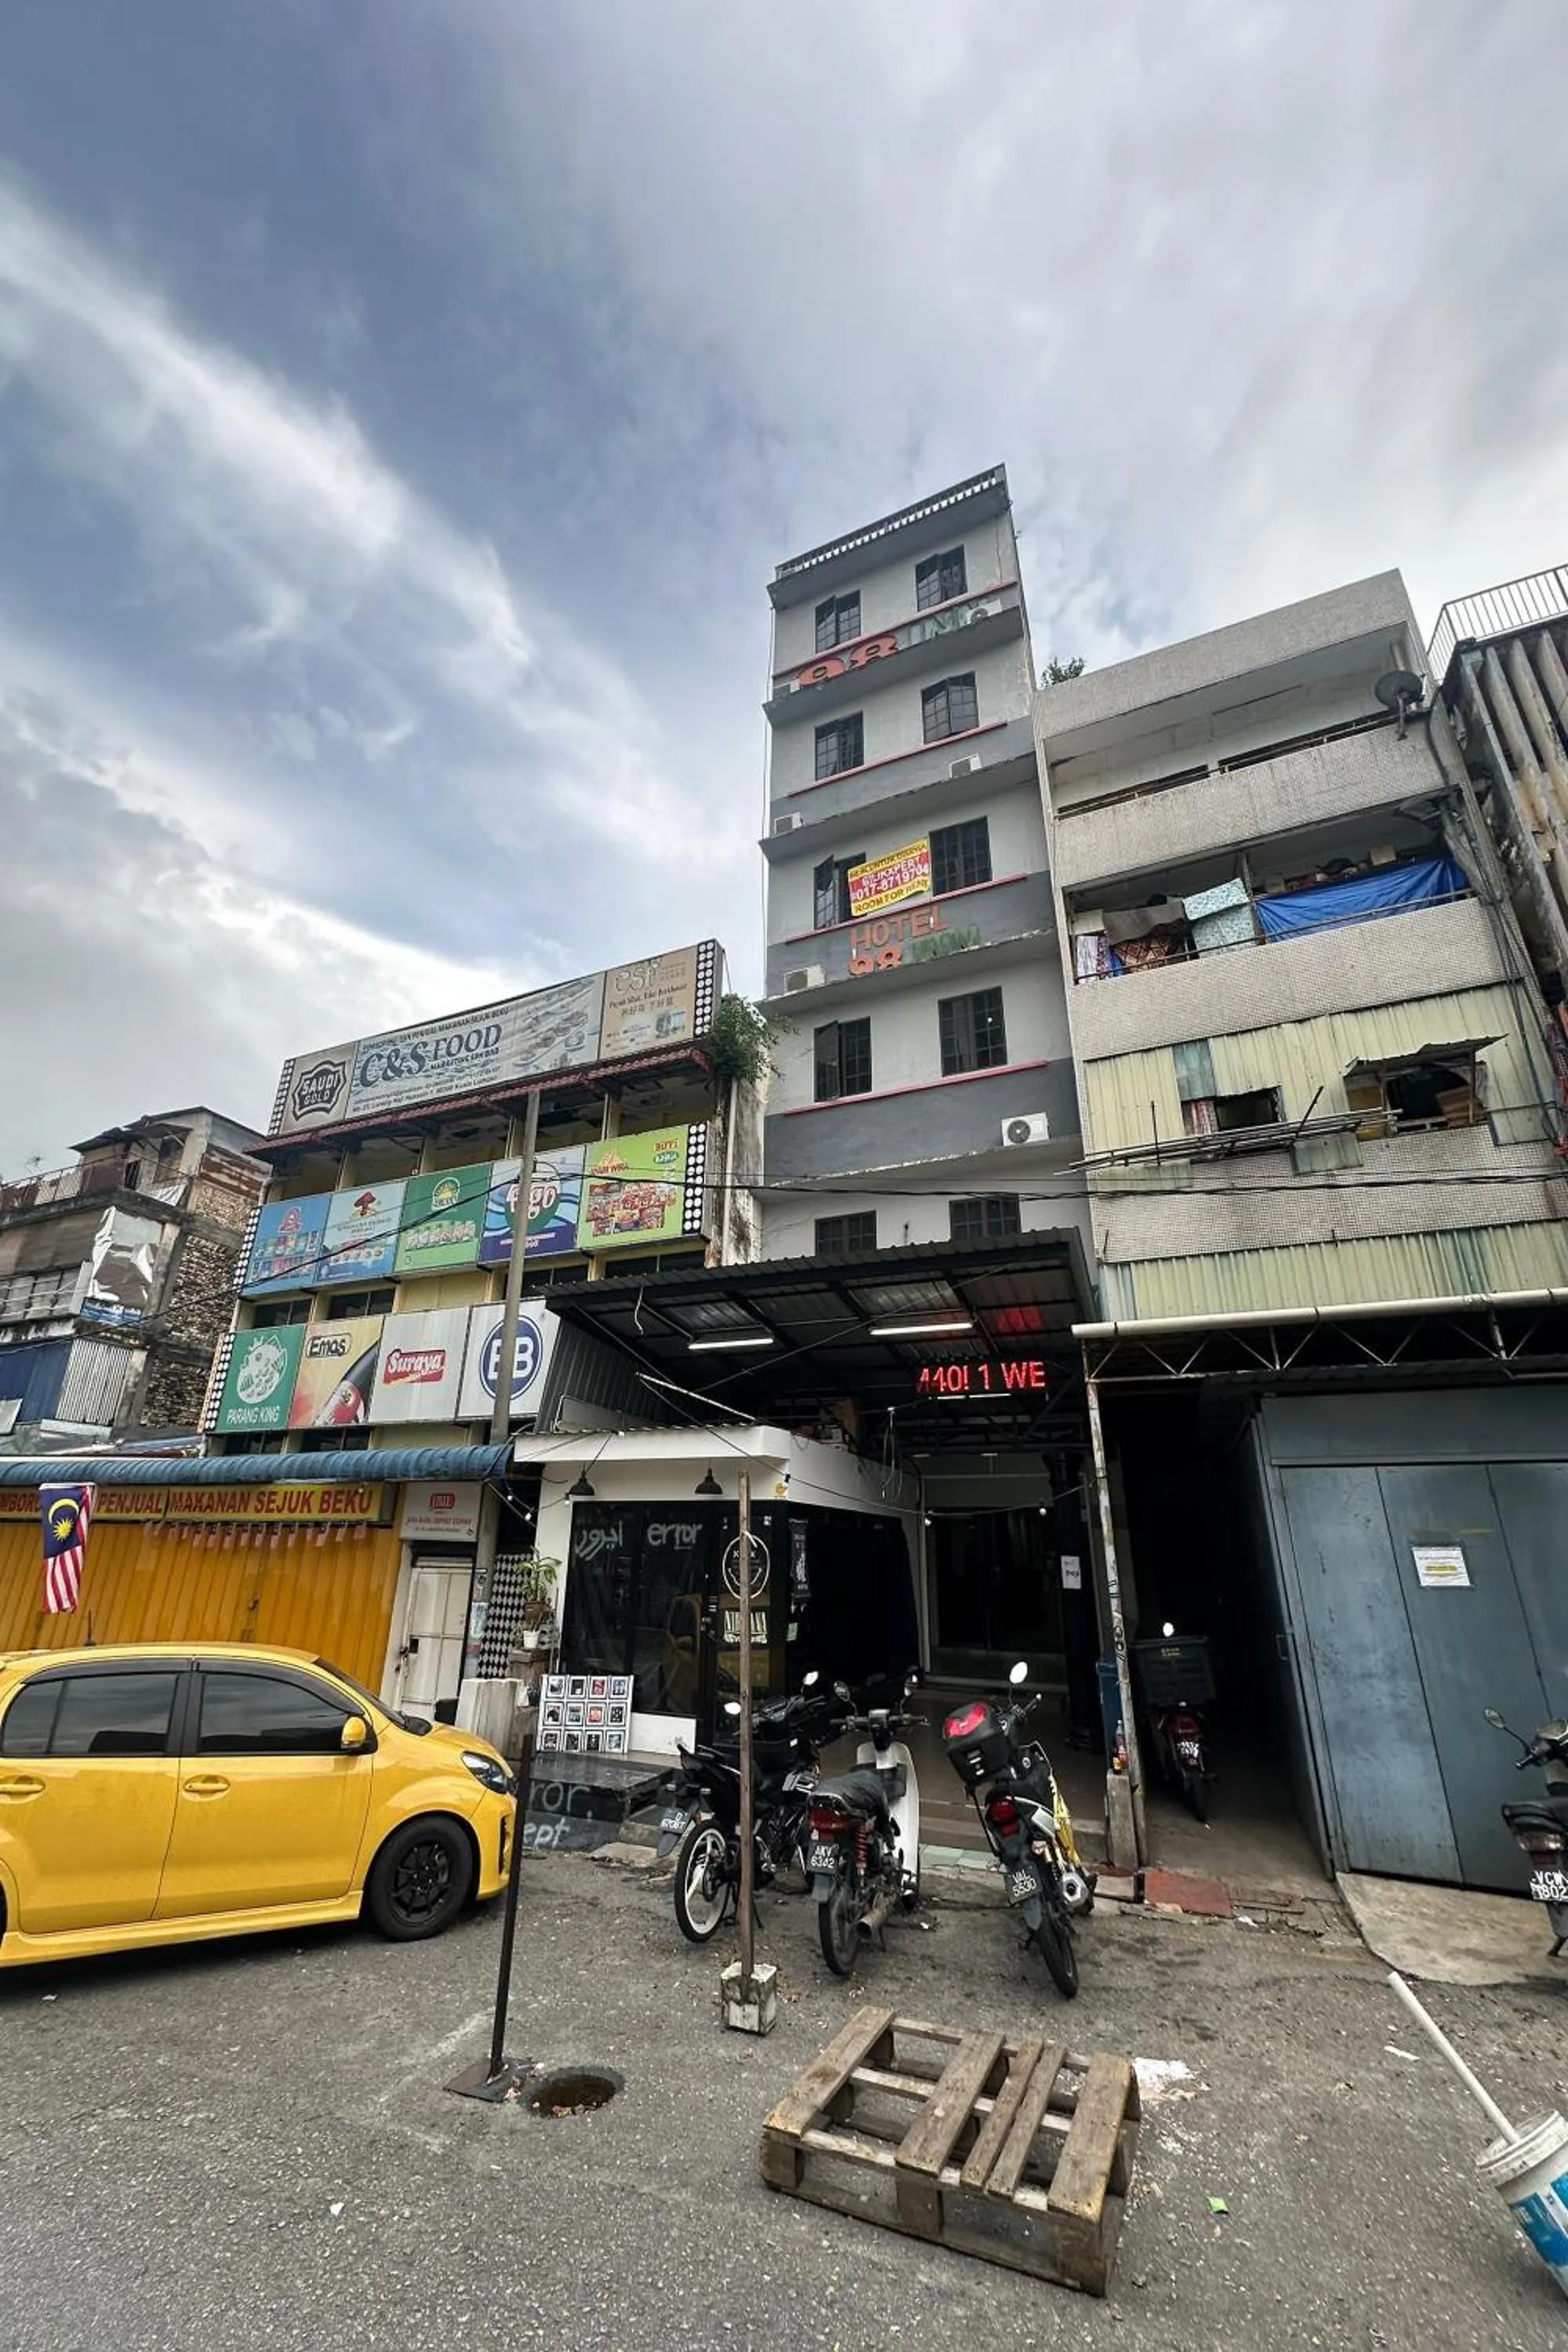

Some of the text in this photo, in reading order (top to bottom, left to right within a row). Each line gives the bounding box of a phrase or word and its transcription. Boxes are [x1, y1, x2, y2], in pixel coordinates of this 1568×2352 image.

[885, 888, 905, 901] FOR
[850, 906, 950, 950] HOTEL
[360, 1041, 429, 1087] C&S
[433, 1024, 503, 1062] FOOD
[301, 1072, 339, 1095] SAUDI
[388, 1350, 444, 1376] Suraya
[1000, 1361, 1046, 1389] WE
[259, 1404, 281, 1423] KING
[96, 1491, 164, 1514] PENJUAL
[169, 1490, 249, 1514] MAKANAN
[254, 1490, 315, 1514] SEJUK
[318, 1489, 372, 1514] BEKU
[648, 1523, 703, 1546] error
[523, 1816, 572, 1851] ept
